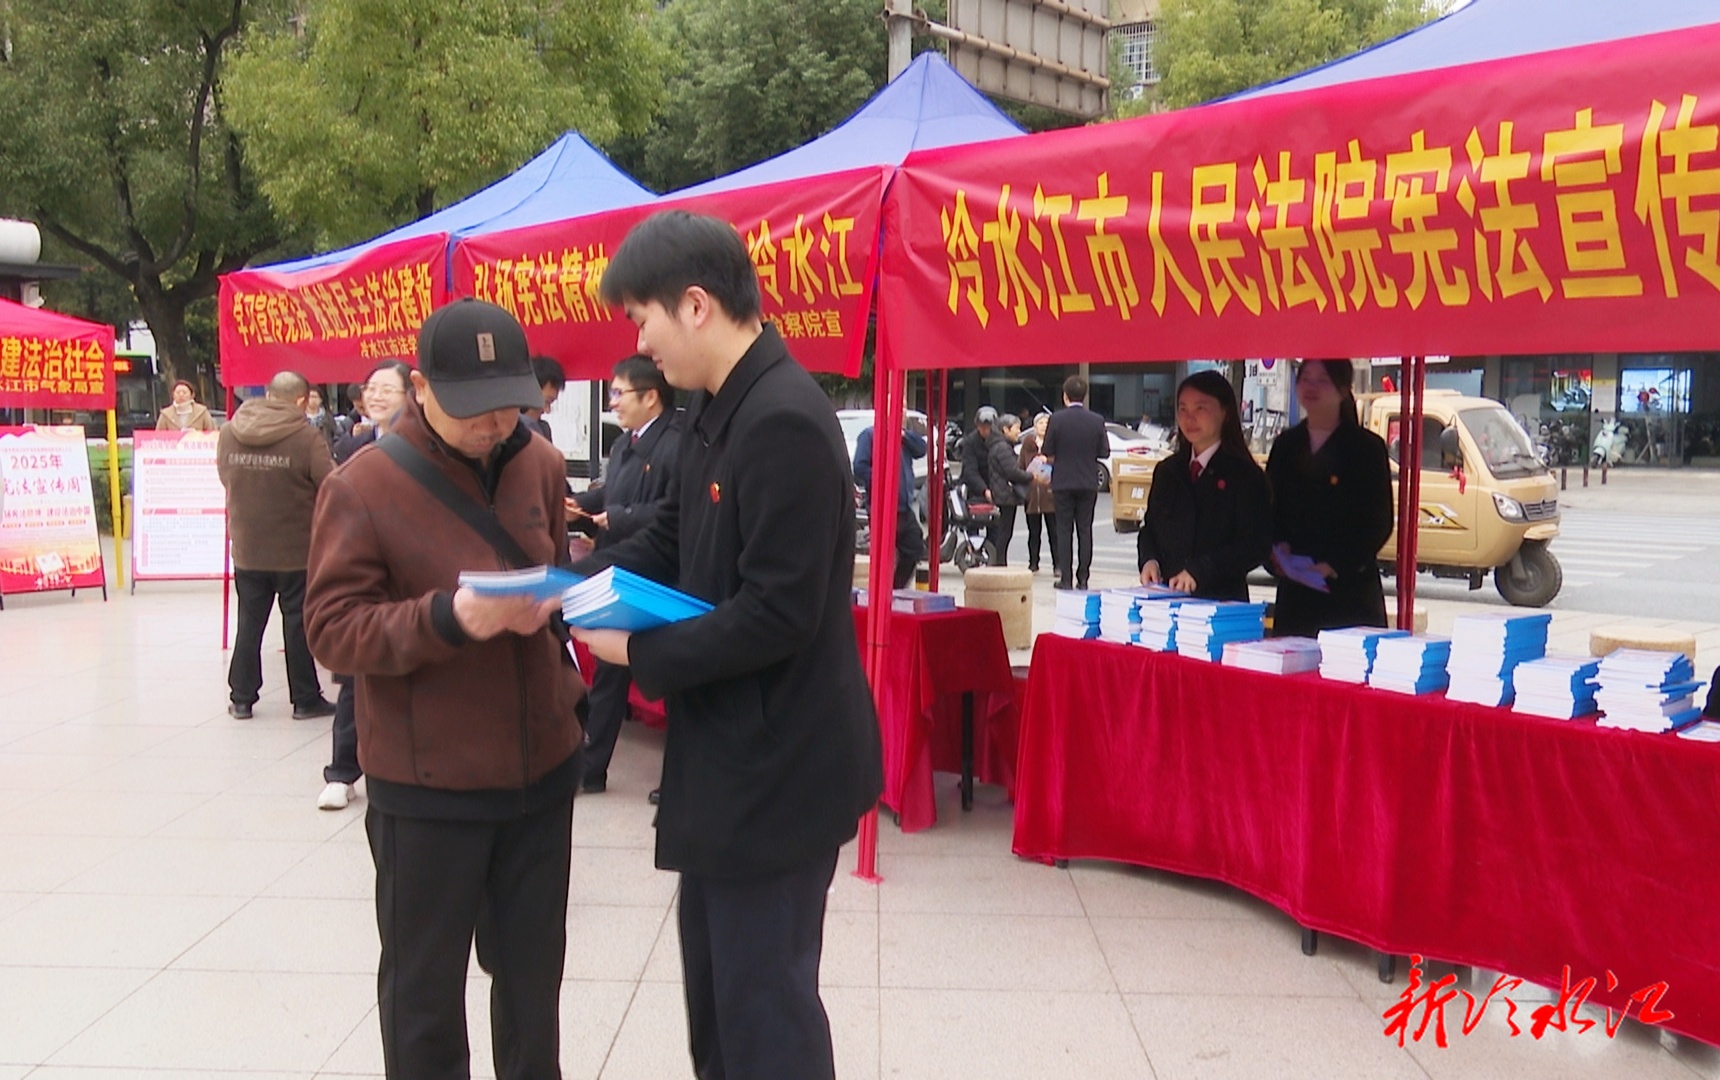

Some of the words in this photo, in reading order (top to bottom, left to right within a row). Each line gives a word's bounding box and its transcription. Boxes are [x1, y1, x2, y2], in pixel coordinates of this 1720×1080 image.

[940, 93, 1720, 330] 冷水江市人民法院宪法宣传
[300, 262, 433, 341] 推进民主法治建设
[474, 242, 613, 327] 弘扬宪法精神
[0, 336, 105, 380] 建法治社会
[10, 454, 63, 470] 2025年
